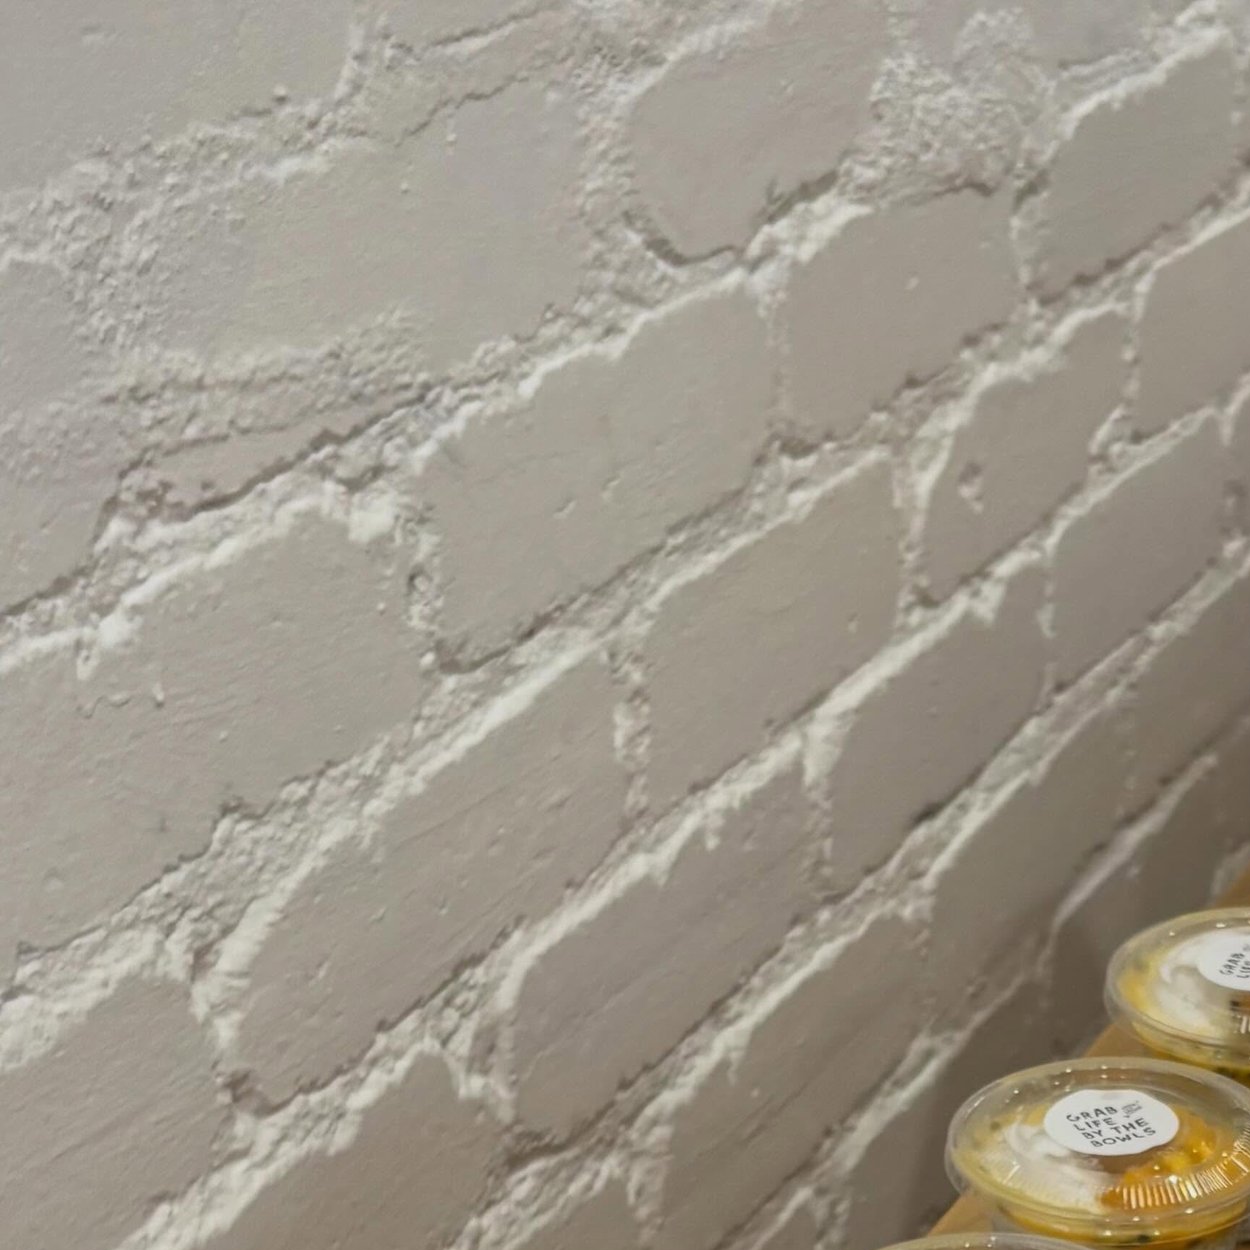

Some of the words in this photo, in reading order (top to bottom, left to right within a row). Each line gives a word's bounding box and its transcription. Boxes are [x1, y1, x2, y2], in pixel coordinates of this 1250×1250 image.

[1220, 952, 1244, 976] GRAB
[1066, 1107, 1118, 1122] GRAB
[1074, 1116, 1114, 1131] LIFE
[1082, 1130, 1102, 1139] BY
[1114, 1119, 1147, 1135] THE
[1091, 1130, 1156, 1147] BOWLS
